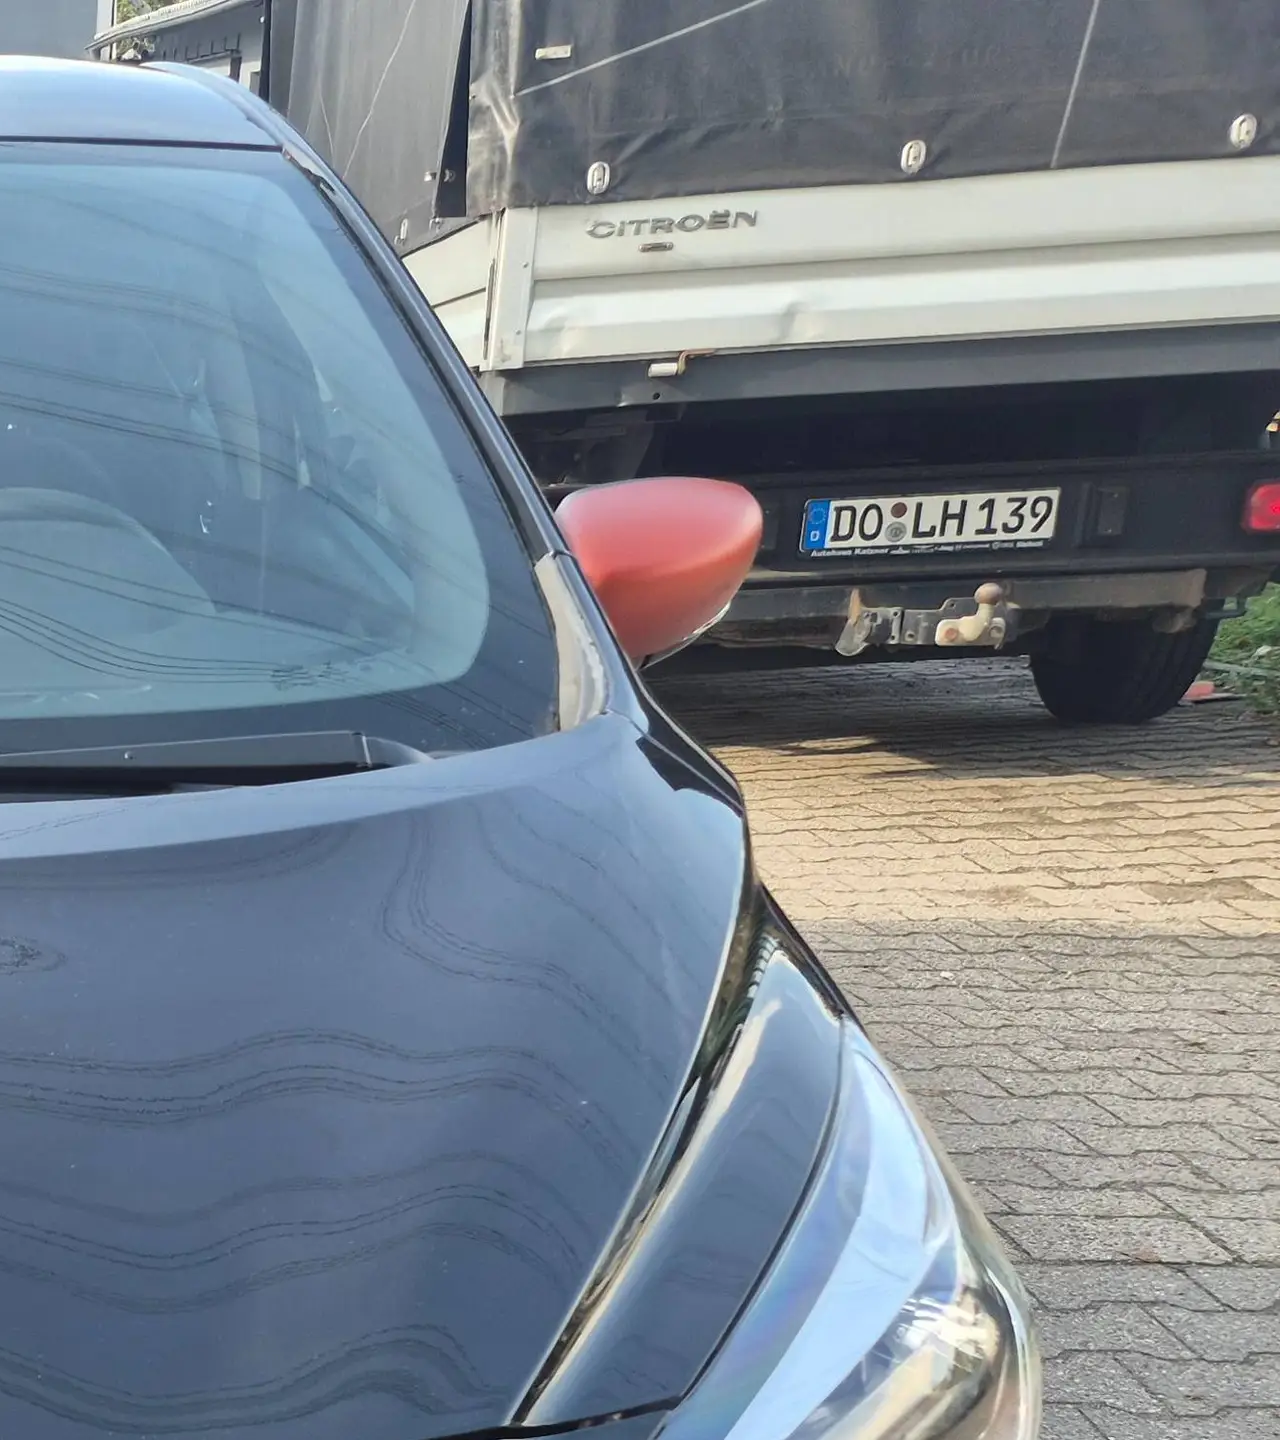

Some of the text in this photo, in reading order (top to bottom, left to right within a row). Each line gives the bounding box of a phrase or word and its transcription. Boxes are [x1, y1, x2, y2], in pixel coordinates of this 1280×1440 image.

[586, 209, 758, 239] CITROËN
[830, 495, 1054, 542] DO LH 139
